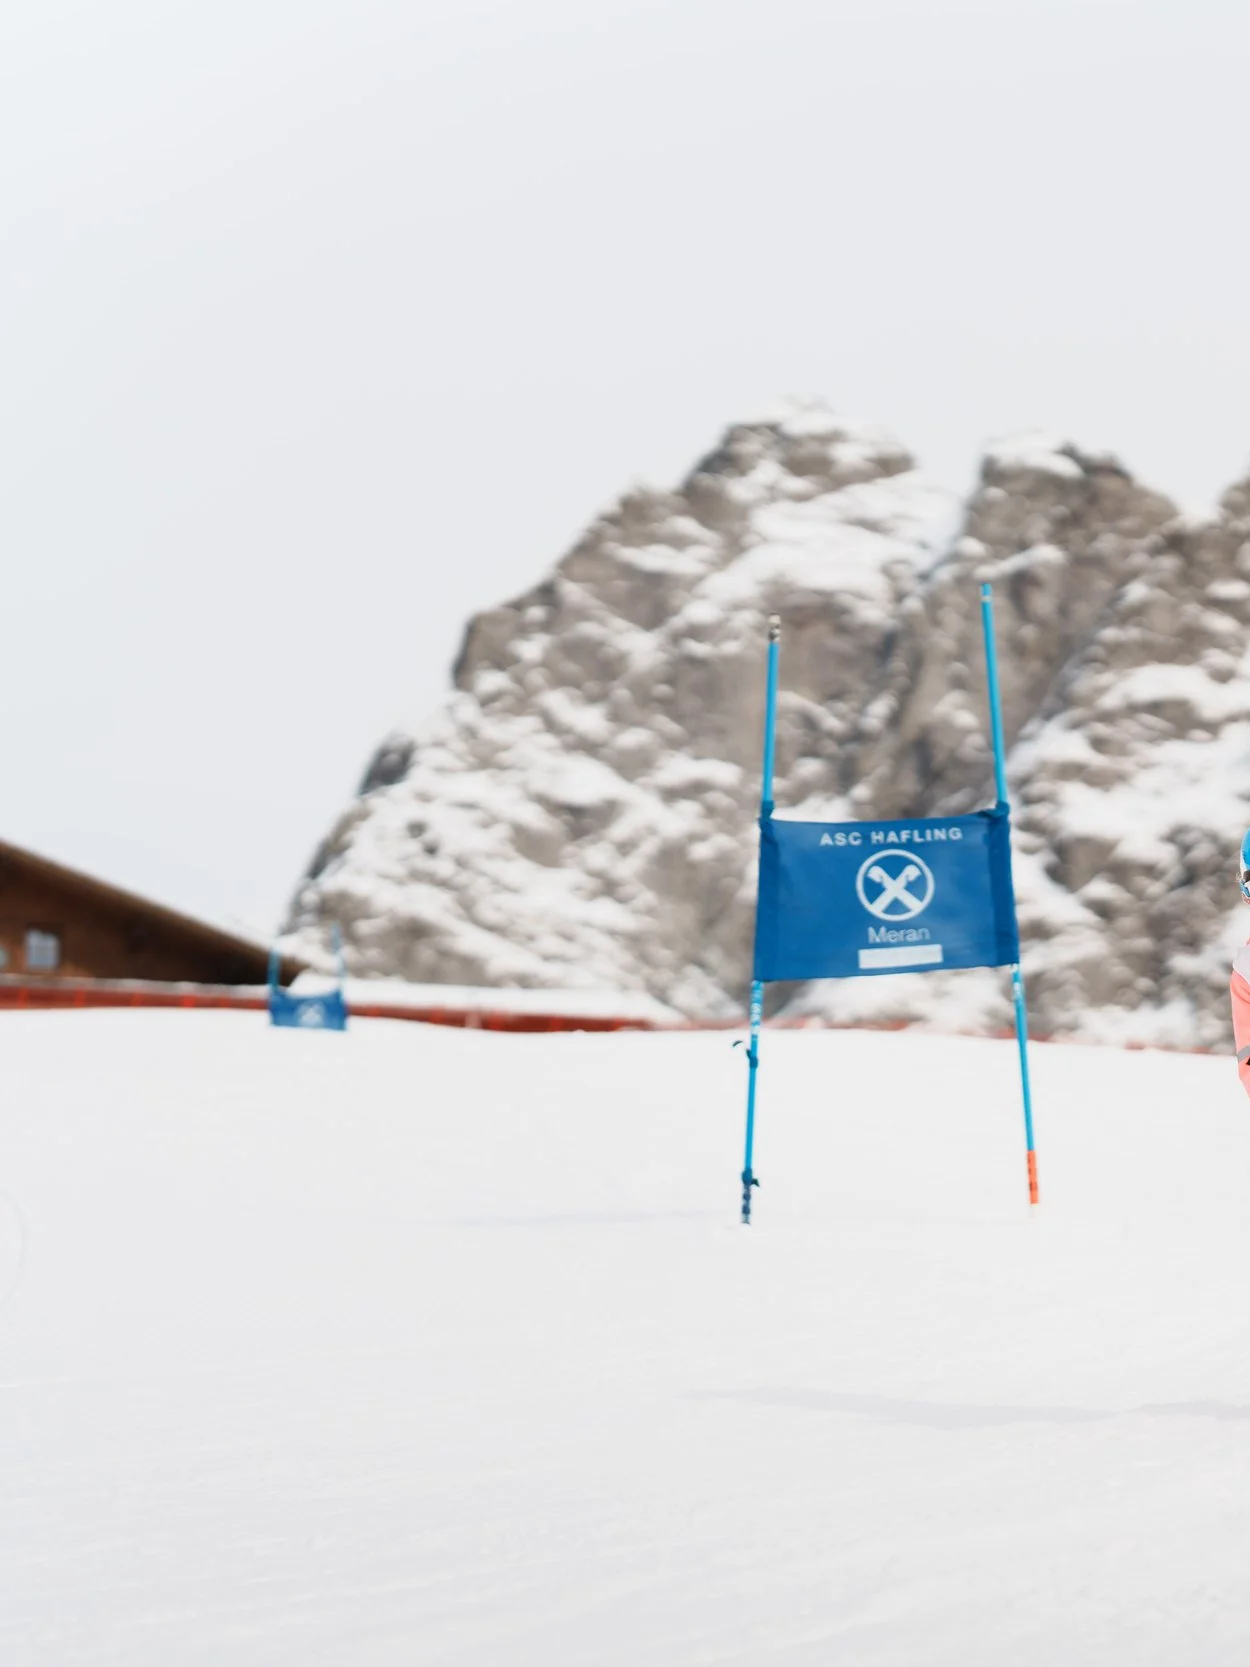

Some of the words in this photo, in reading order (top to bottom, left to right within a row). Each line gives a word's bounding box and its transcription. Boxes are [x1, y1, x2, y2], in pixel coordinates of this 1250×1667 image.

[820, 832, 862, 846] ASC
[870, 827, 963, 845] HAFLING
[868, 926, 931, 944] Meran
